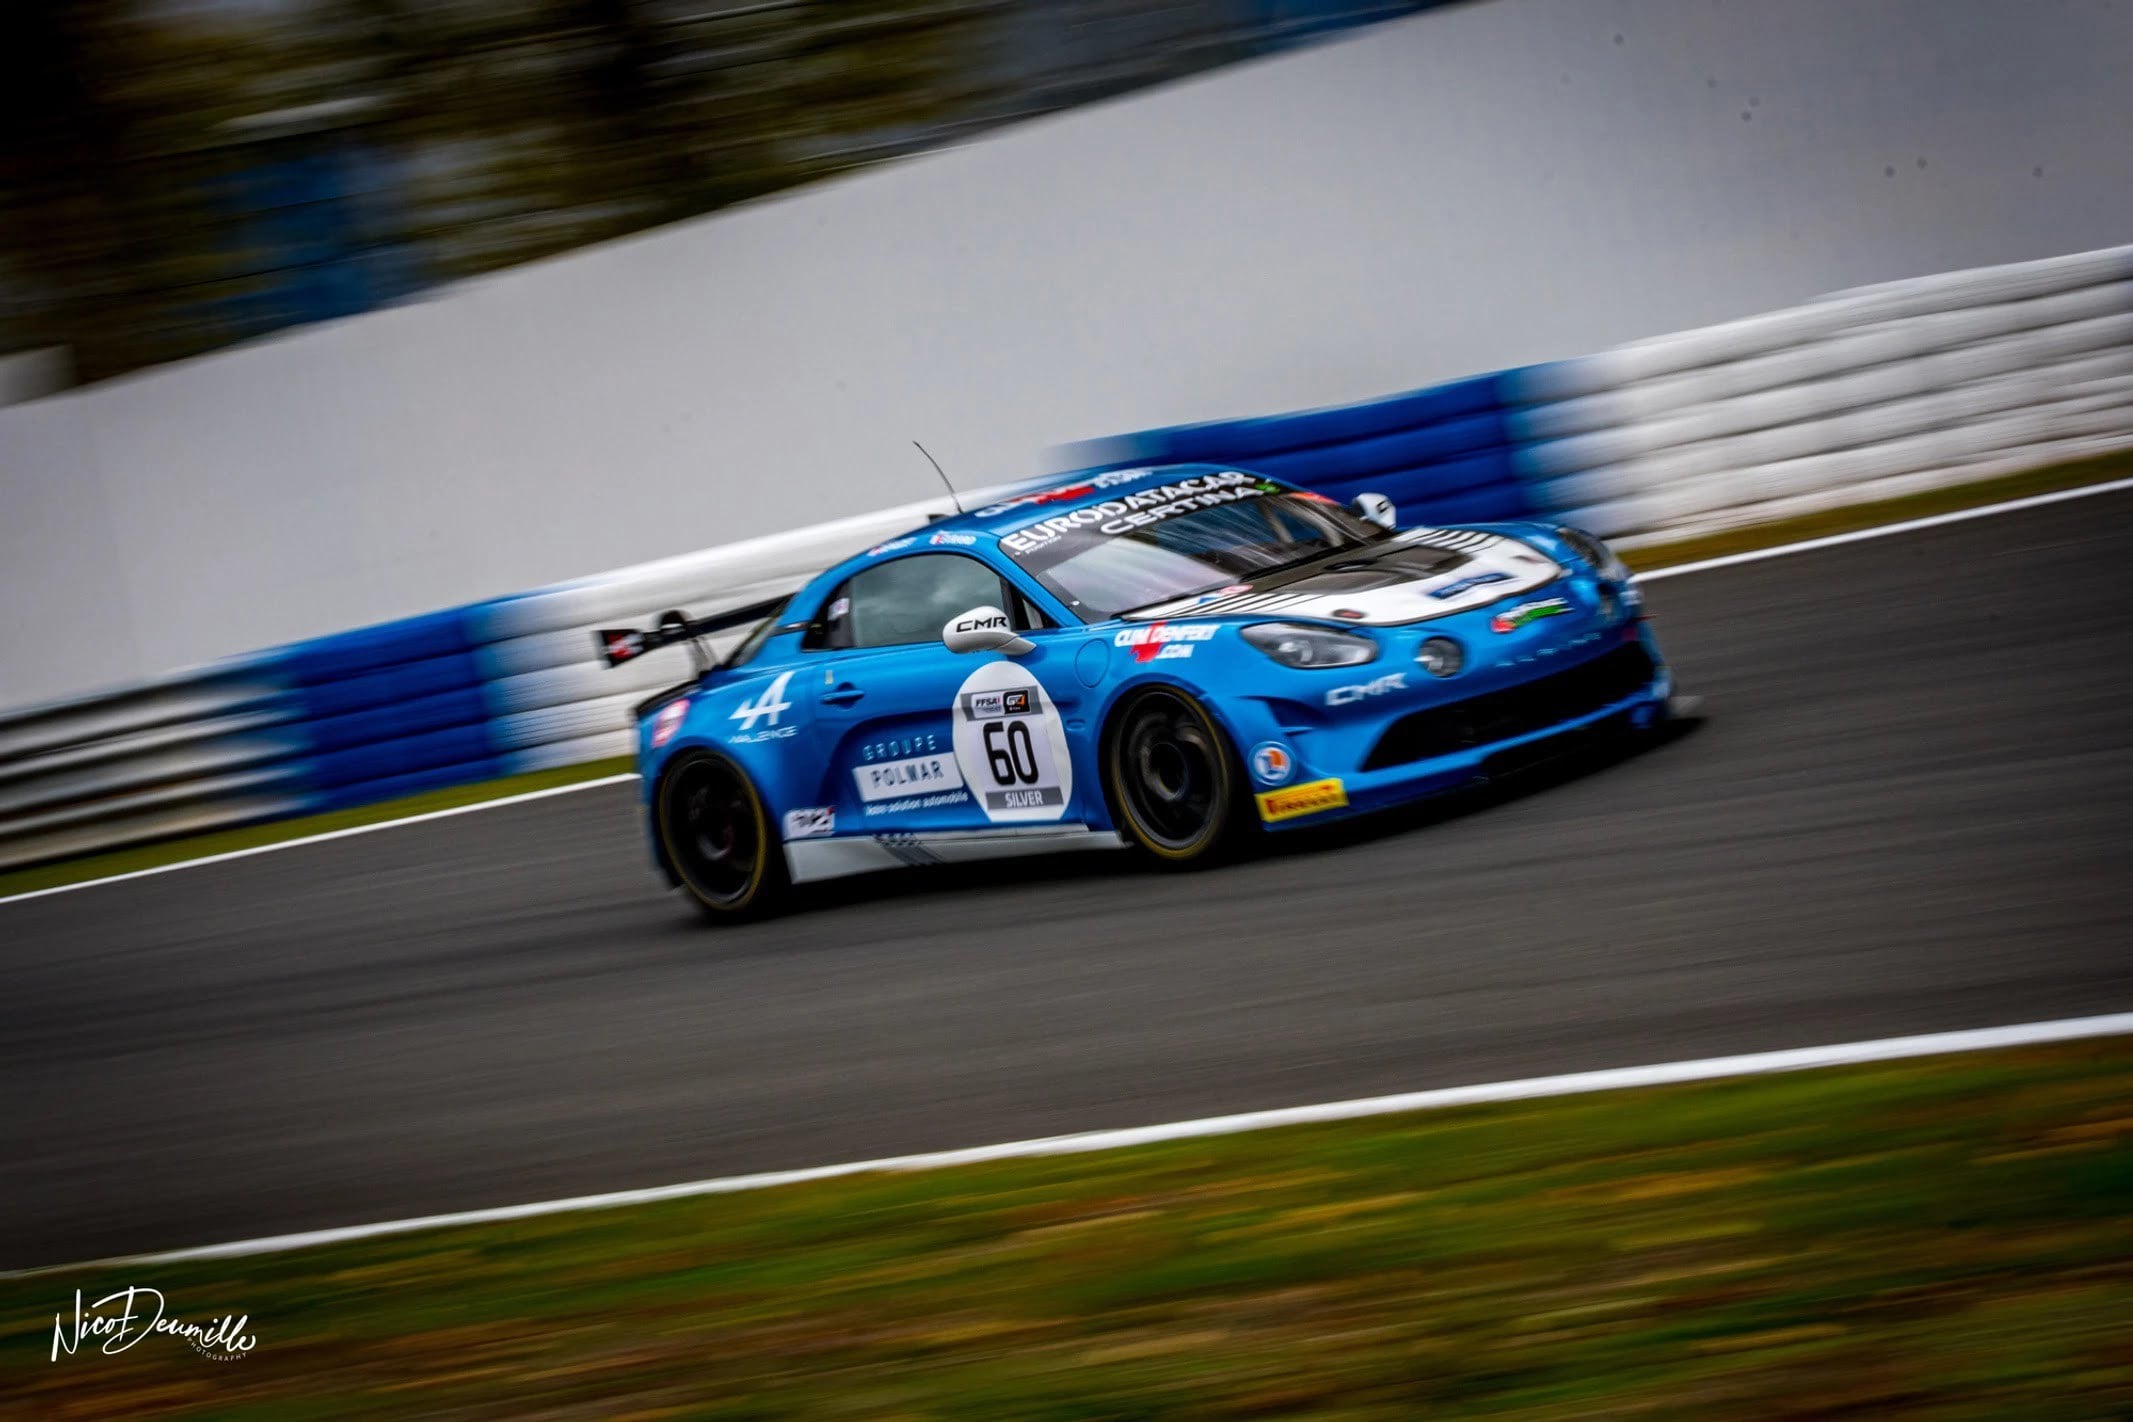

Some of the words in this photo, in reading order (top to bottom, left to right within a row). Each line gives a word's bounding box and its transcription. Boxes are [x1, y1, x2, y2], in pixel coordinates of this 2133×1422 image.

[1001, 471, 1257, 551] EURODATACAR
[1100, 486, 1265, 535] CERTINA
[956, 616, 1008, 633] CMR
[1326, 672, 1409, 706] CMR
[863, 734, 937, 761] GROUPE
[983, 720, 1039, 786] 60
[870, 760, 944, 789] POLMAR
[1005, 790, 1044, 809] SILVER
